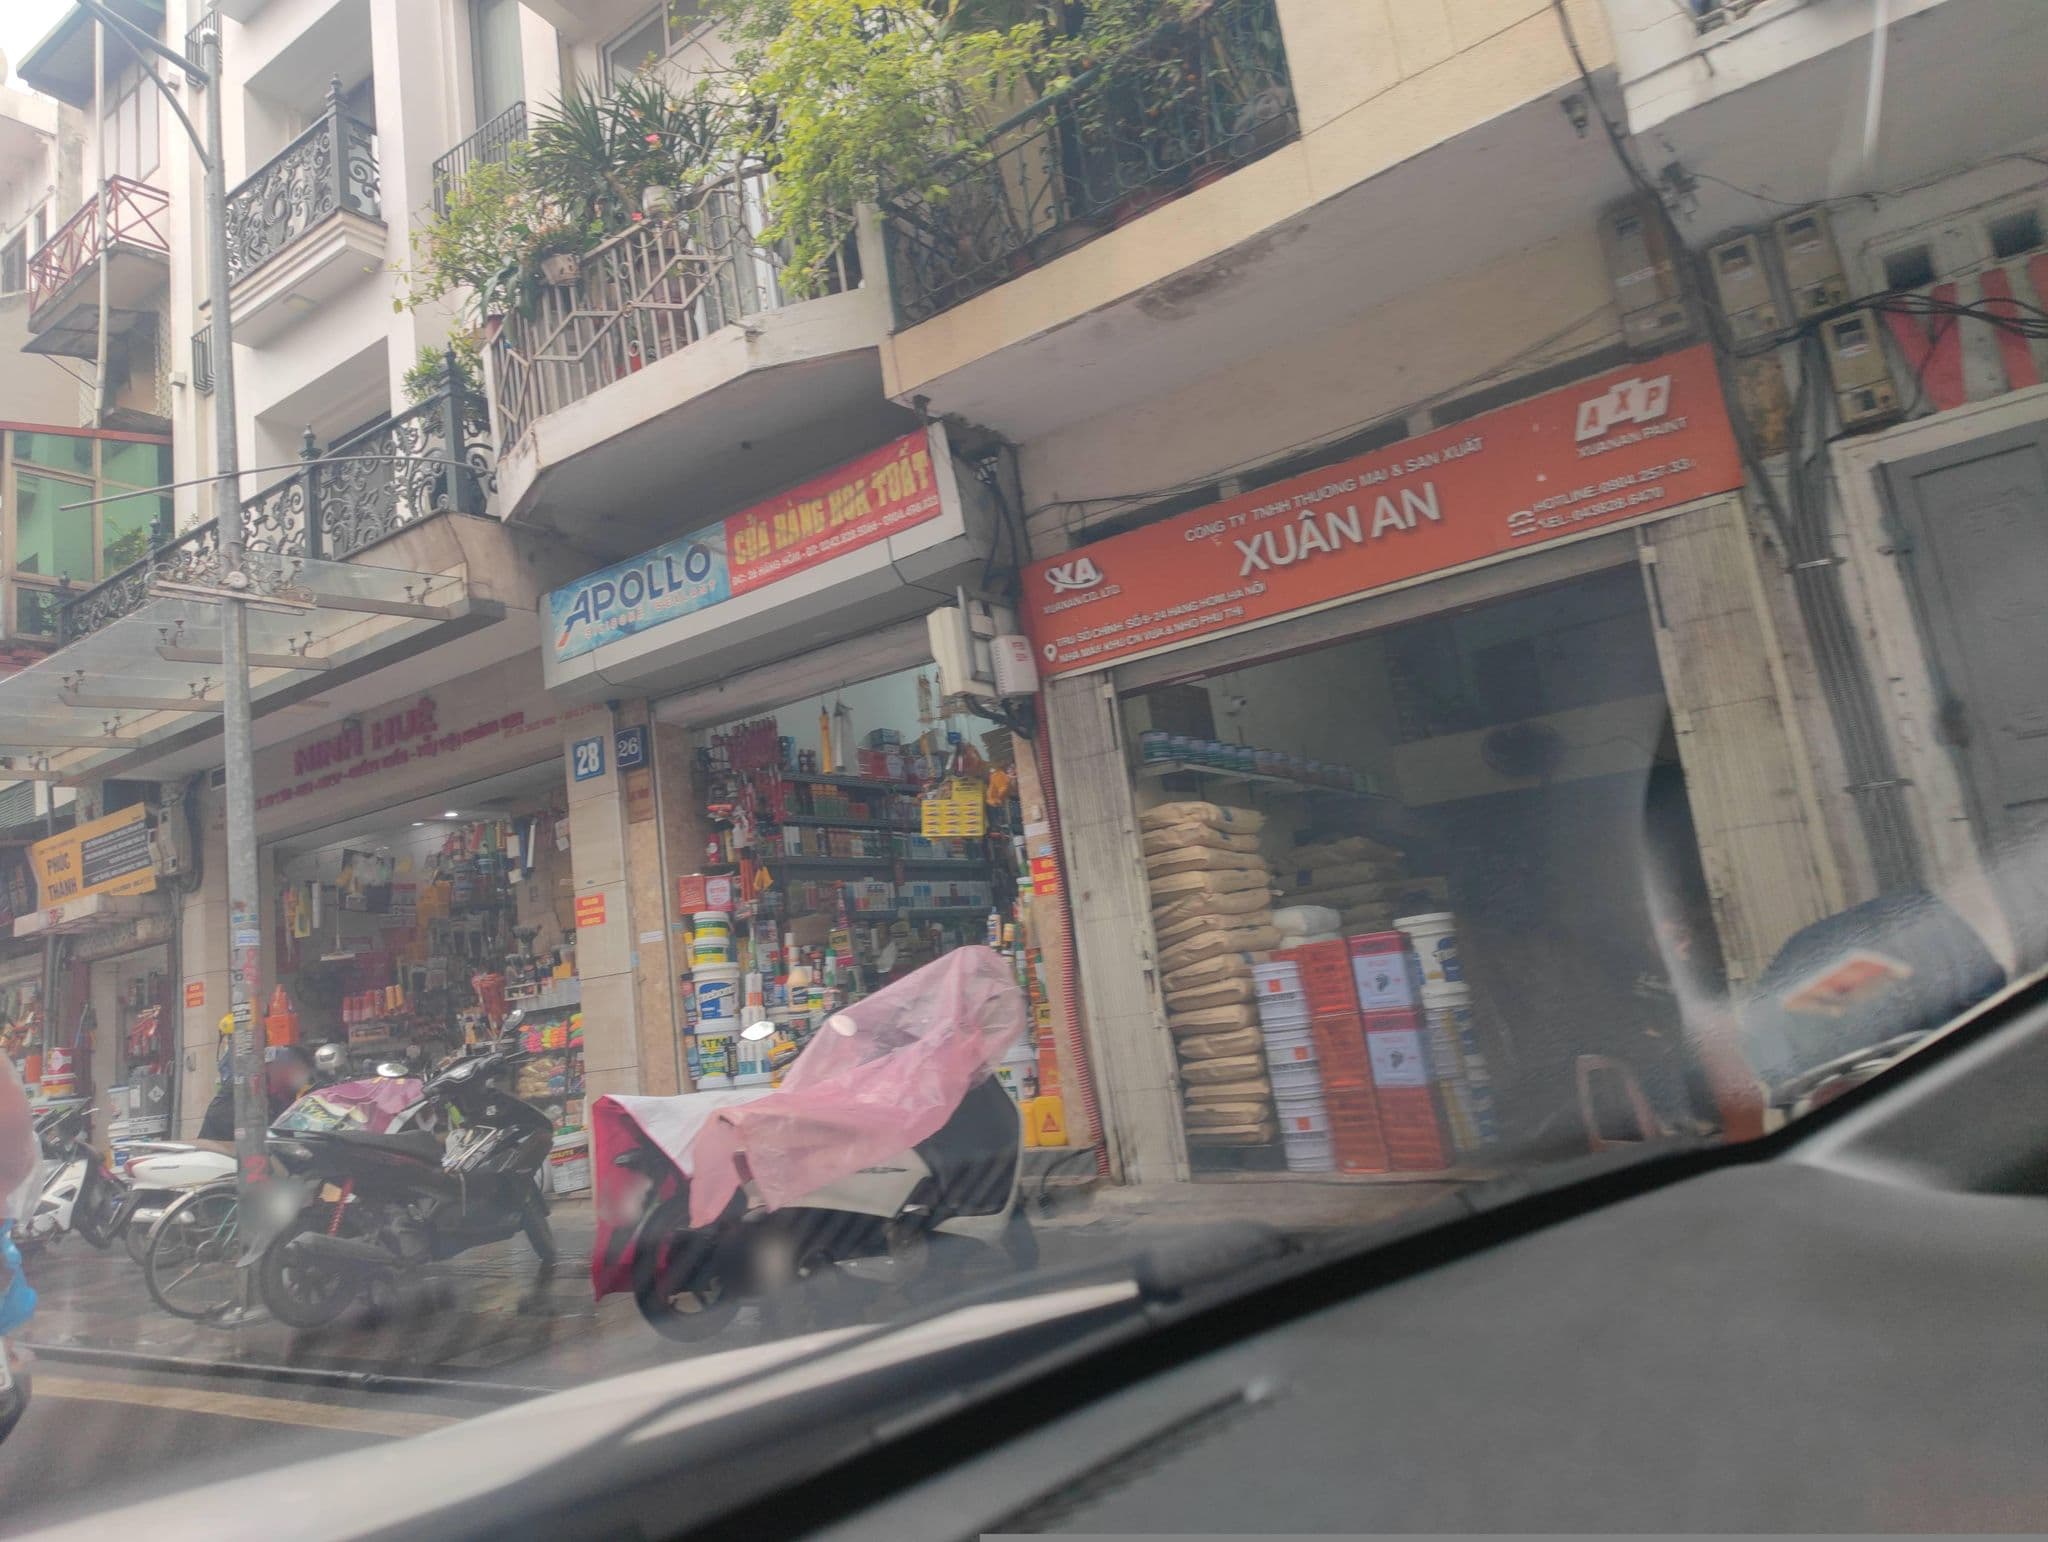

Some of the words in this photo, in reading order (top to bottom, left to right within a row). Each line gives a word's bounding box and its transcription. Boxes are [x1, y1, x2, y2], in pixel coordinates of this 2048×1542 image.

[1580, 382, 1666, 433] AXP
[773, 498, 825, 550] HÀNG
[1184, 517, 1226, 541] CÔNG
[1229, 512, 1247, 528] TY
[1250, 499, 1292, 521] TNHH
[1391, 463, 1404, 477] &
[1233, 504, 1363, 577] XUÂN
[1370, 481, 1441, 538] AN
[556, 543, 711, 646] APOLLO
[1050, 557, 1098, 586] XA
[576, 741, 601, 777] 28
[617, 736, 640, 758] 26
